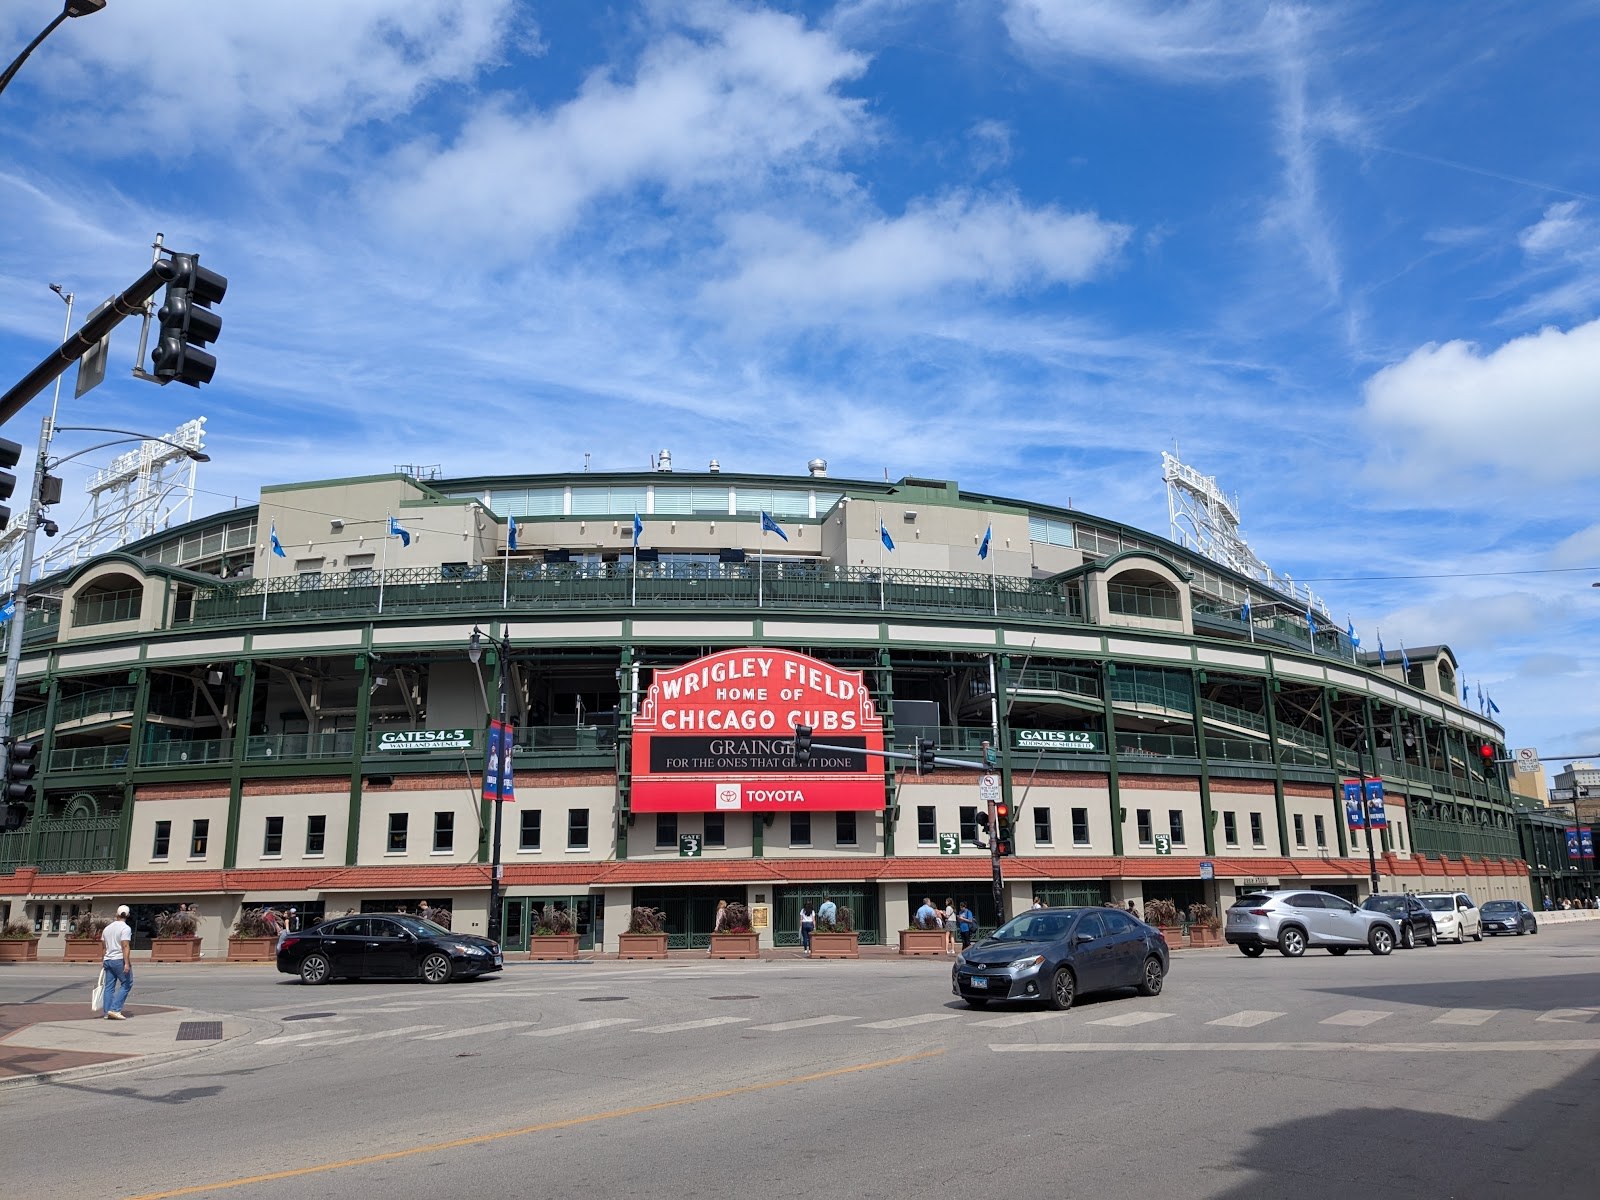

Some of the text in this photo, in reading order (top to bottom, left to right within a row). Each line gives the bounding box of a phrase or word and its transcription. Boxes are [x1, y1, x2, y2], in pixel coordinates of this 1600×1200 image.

[661, 657, 855, 701] WRIGLEY FIELD
[716, 688, 804, 701] HOME OF
[661, 709, 857, 731] CHICAGO CUBS
[1020, 730, 1066, 741] GATES
[710, 739, 807, 755] GRAINGE
[666, 757, 689, 768] FOR
[692, 757, 714, 768] THE
[717, 757, 748, 768] ONES
[751, 757, 780, 768] THAT
[820, 757, 852, 768] DONE
[746, 790, 804, 802] TOYOTA
[683, 839, 698, 852] 3
[943, 837, 956, 850] 3
[1158, 838, 1169, 851] 3
